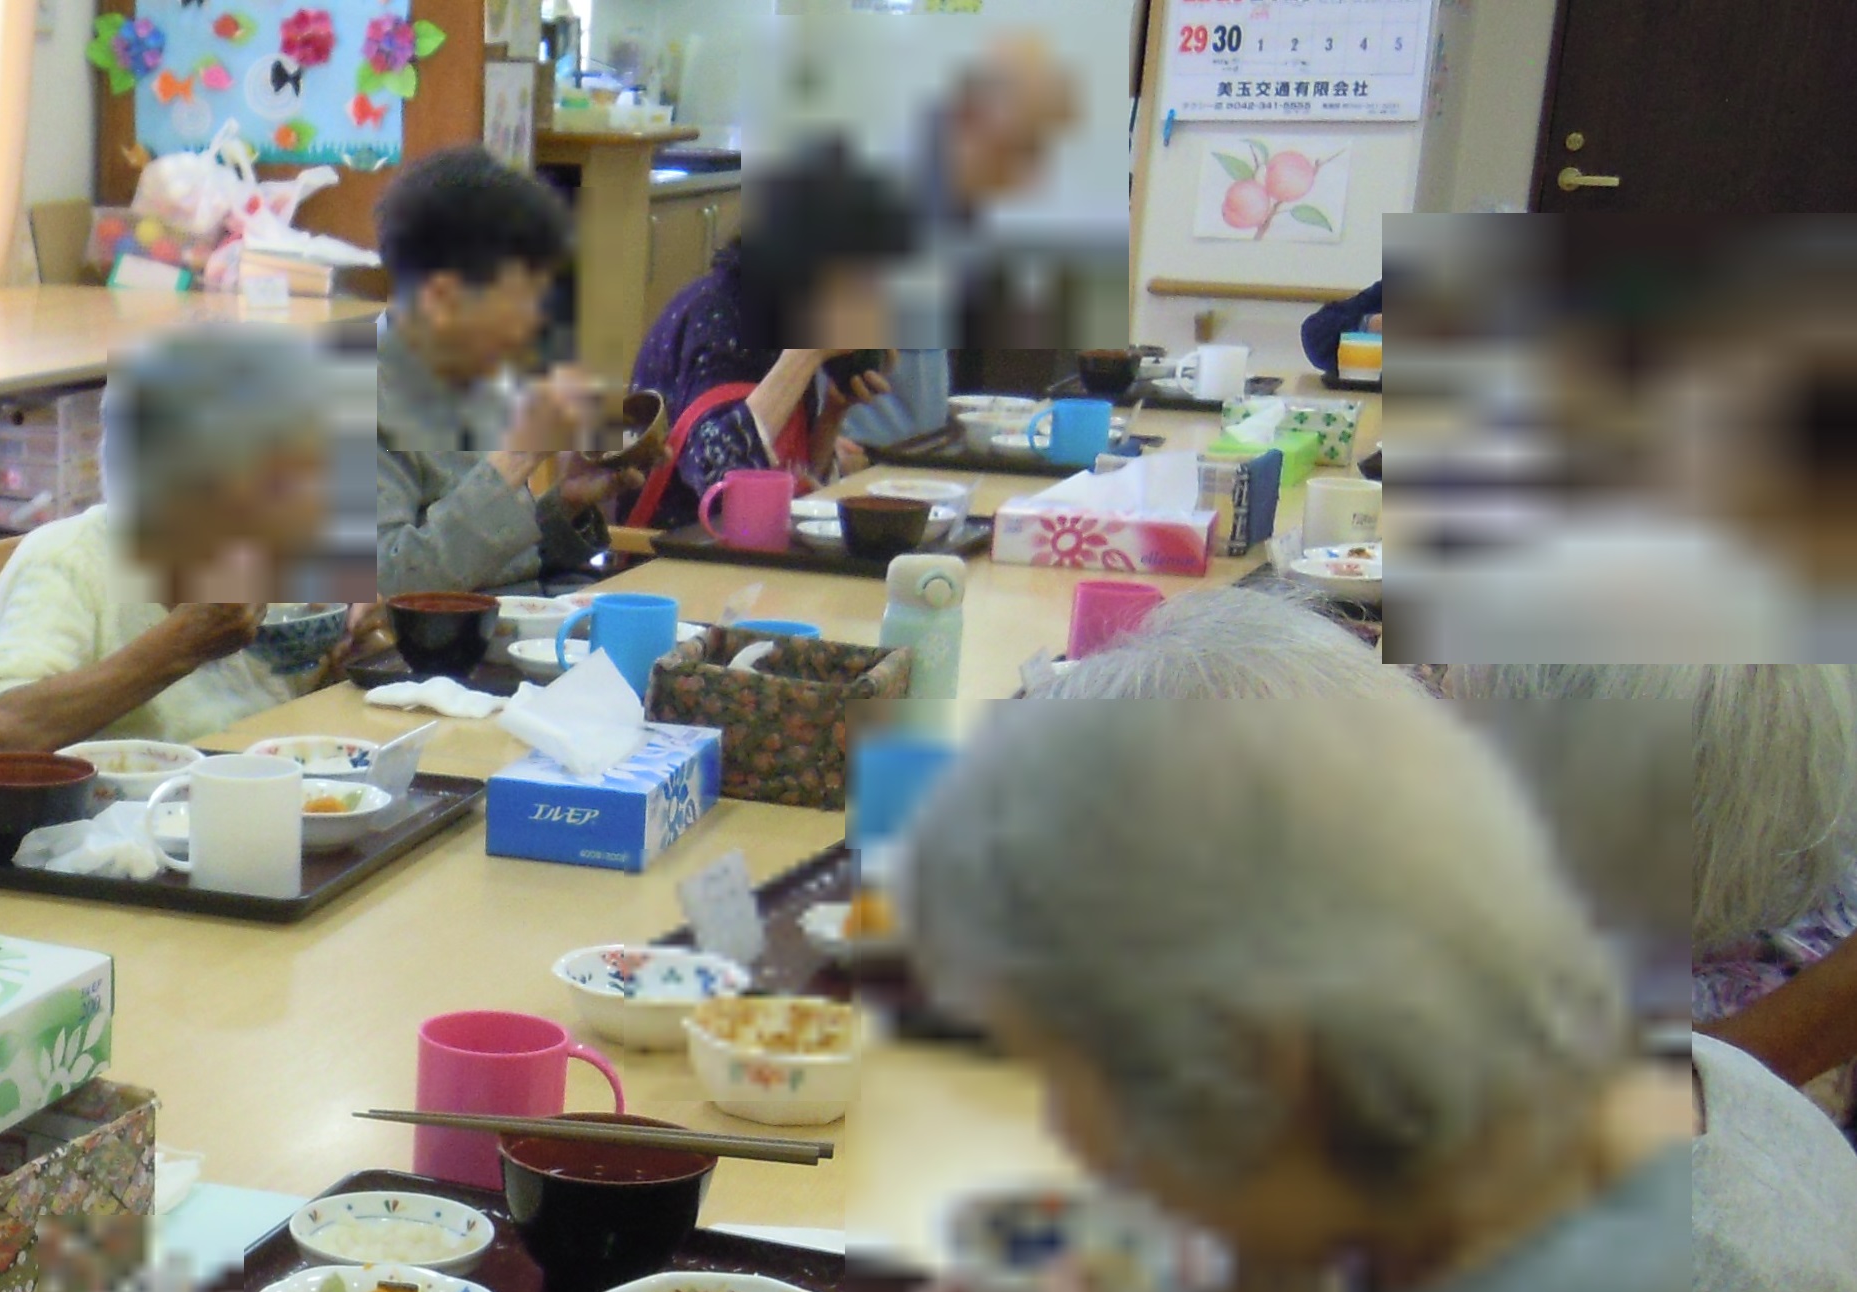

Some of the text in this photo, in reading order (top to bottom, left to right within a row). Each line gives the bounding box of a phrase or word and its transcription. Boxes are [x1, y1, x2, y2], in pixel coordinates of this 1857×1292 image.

[1179, 24, 1403, 53] 29 30 1 2 3 4 5
